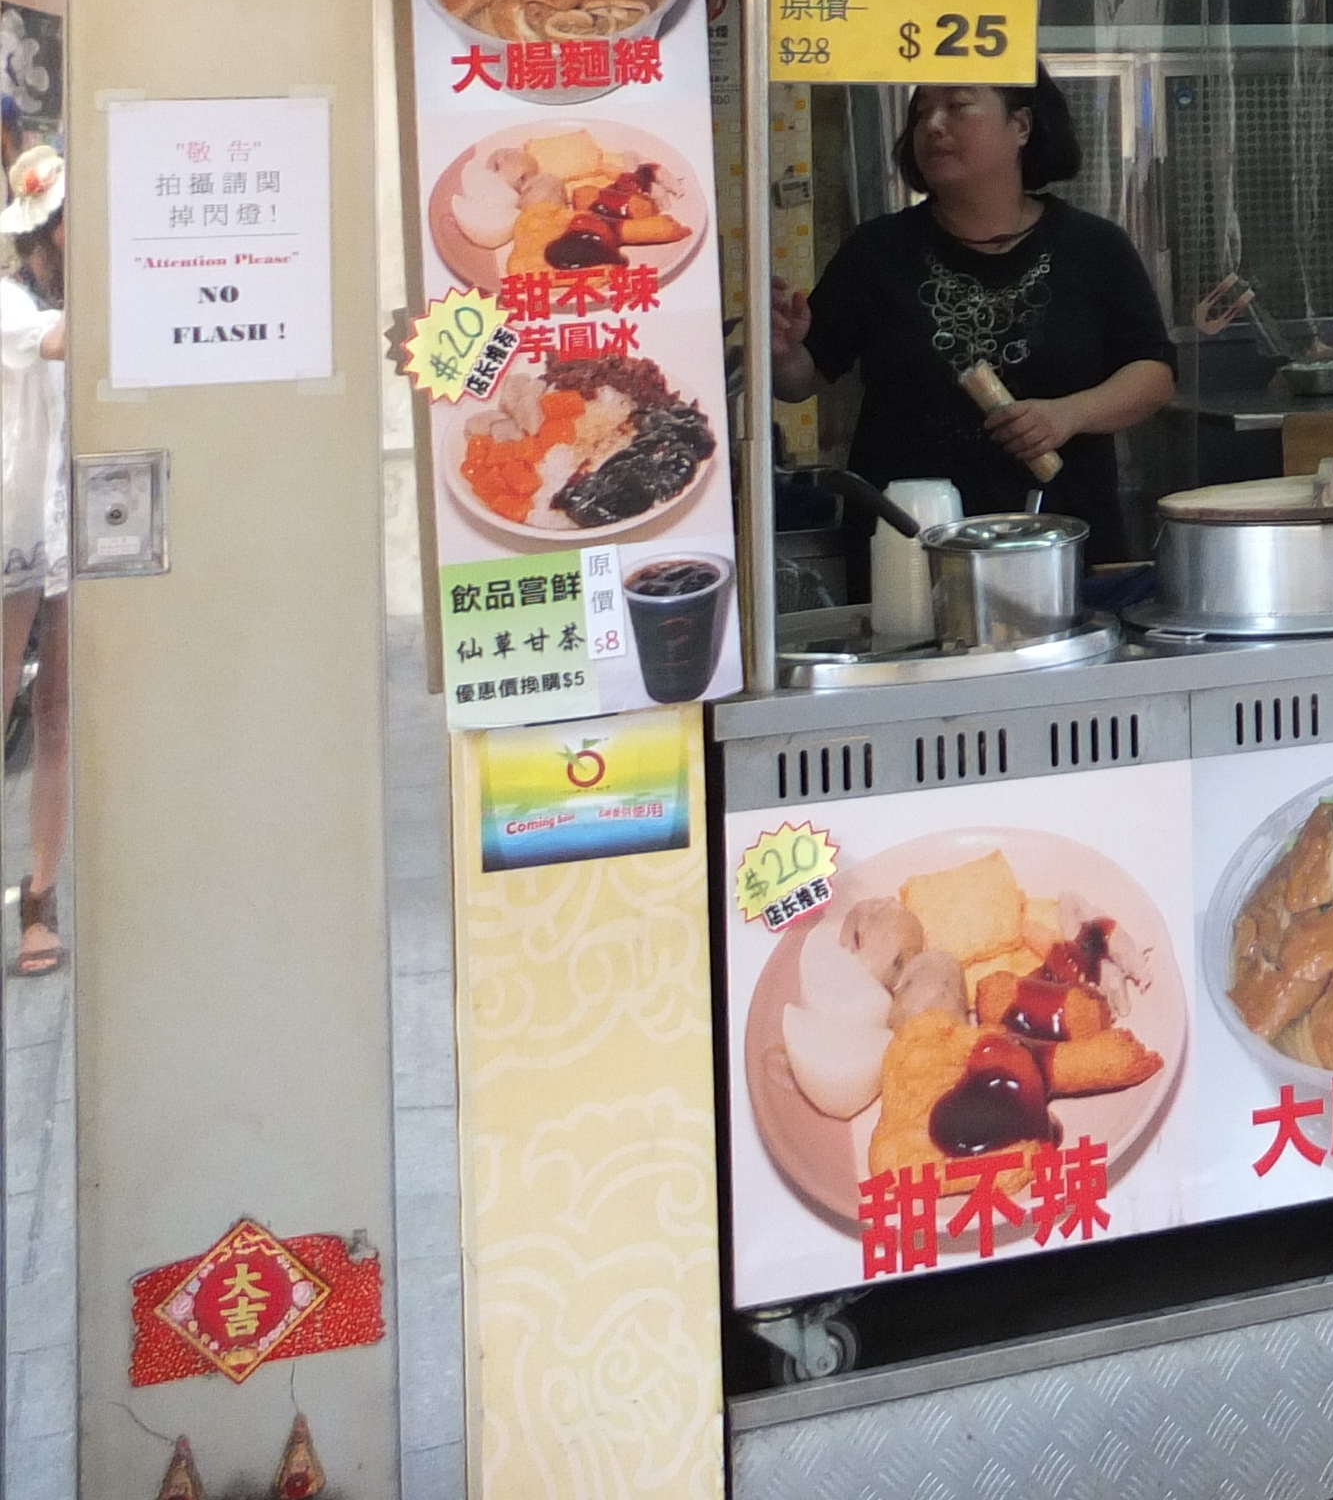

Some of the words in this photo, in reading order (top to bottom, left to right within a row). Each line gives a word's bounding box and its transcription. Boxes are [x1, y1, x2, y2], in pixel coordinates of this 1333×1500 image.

[778, 36, 831, 65] $28
[934, 12, 1008, 58] 25
[451, 36, 664, 94] 大腸麵線
[197, 285, 241, 304] NO
[500, 263, 661, 322] 甜不辣
[171, 323, 269, 345] FLASH
[456, 624, 586, 664] 仙草甘茶
[506, 814, 556, 835] Coming
[857, 1134, 1112, 1281] 甜不辣
[218, 1263, 272, 1338] 大吉
